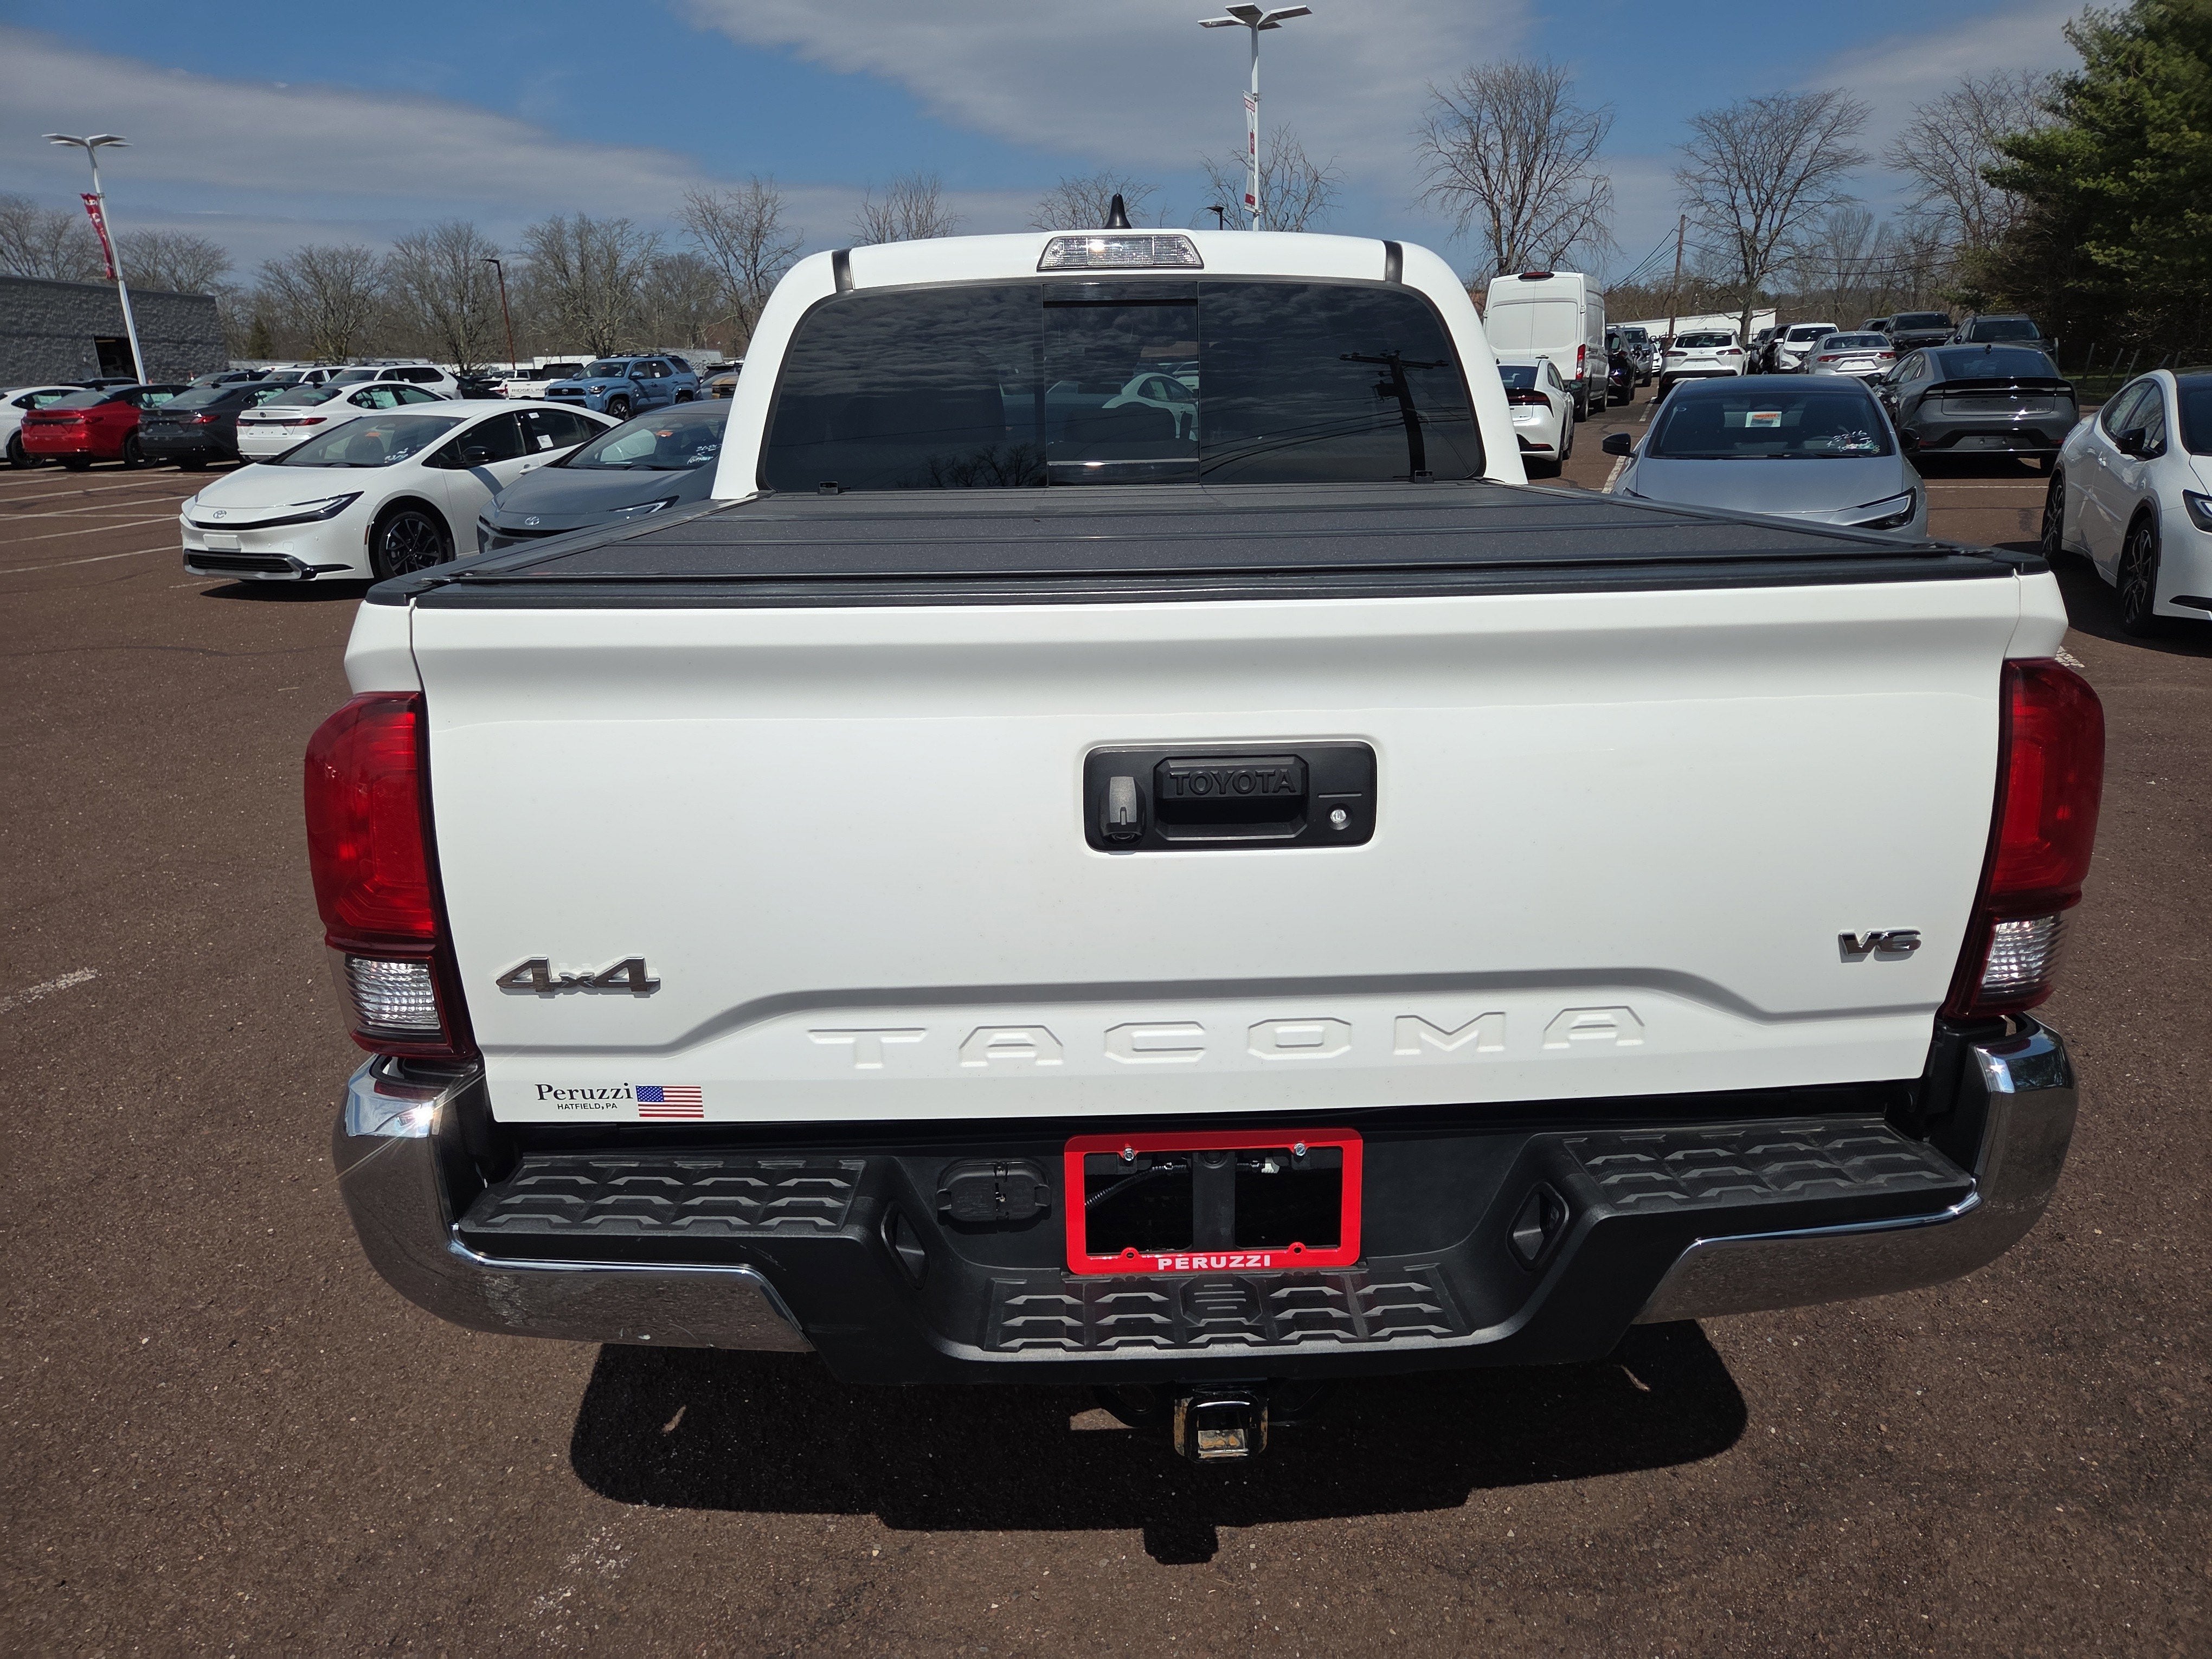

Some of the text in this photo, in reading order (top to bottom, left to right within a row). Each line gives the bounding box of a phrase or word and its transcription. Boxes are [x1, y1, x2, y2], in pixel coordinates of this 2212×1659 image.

[1169, 768, 1297, 796] TOYOTA
[1838, 930, 1921, 955] V6
[496, 955, 661, 993] 4x4
[807, 1006, 1644, 1069] TACOMA
[535, 1083, 634, 1101] Peruzzi
[1158, 1255, 1271, 1270] PERUZZI
